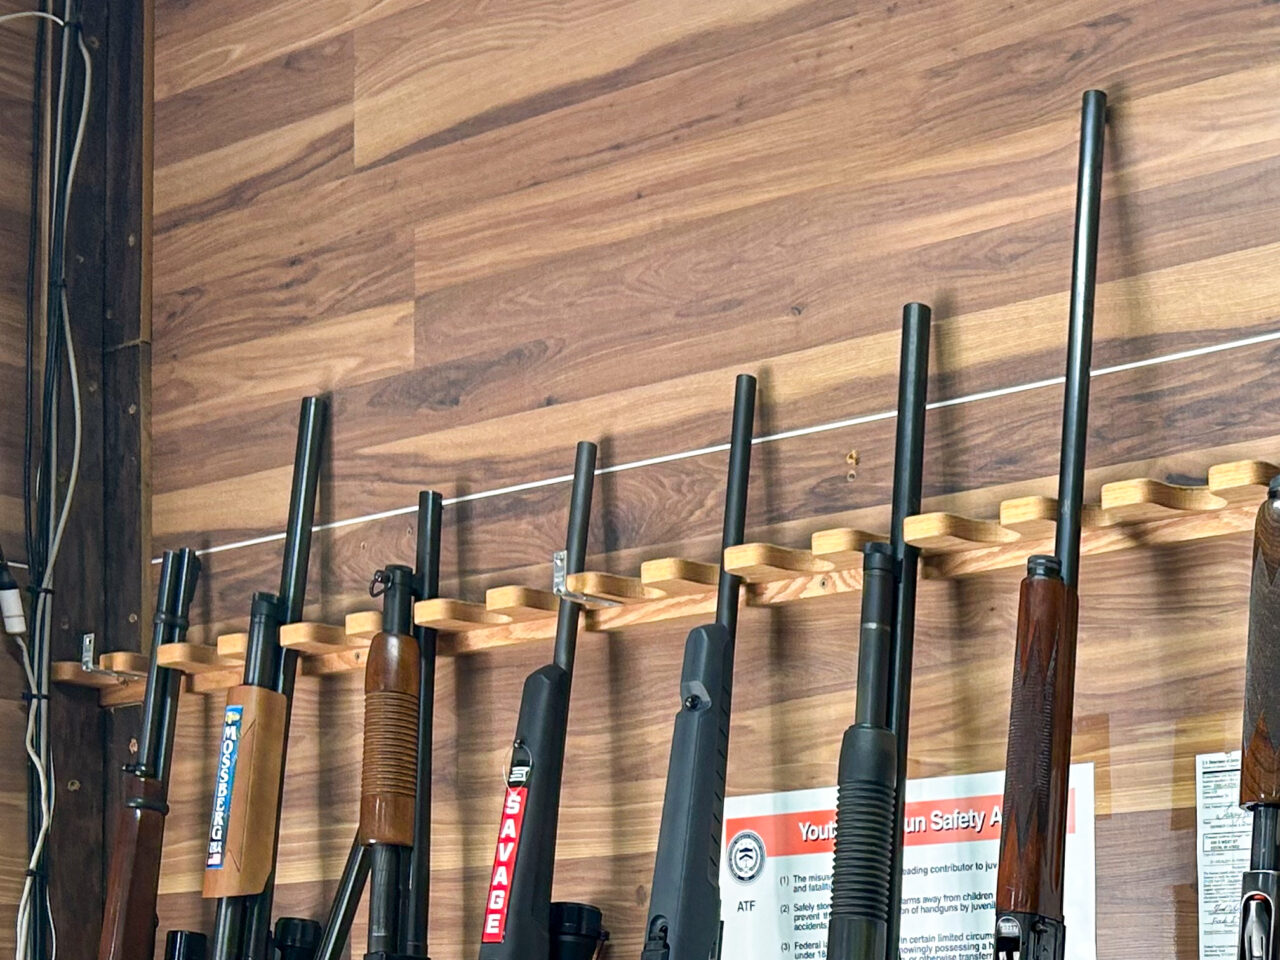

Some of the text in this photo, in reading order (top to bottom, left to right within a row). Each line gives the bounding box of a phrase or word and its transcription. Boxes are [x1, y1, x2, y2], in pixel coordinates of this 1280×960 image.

[211, 724, 236, 841] MOSSBERG
[798, 821, 838, 842] Yout
[930, 808, 985, 833] Safety
[485, 794, 521, 934] SAVAGE
[930, 863, 974, 873] contributor
[975, 862, 983, 870] to
[793, 885, 807, 893] and
[738, 900, 756, 912] ATF
[793, 902, 815, 912] Safely
[922, 896, 941, 906] away
[943, 894, 960, 902] from
[962, 892, 993, 900] children
[794, 912, 820, 923] prevent
[911, 906, 919, 914] of
[920, 904, 958, 914] handguns
[960, 904, 971, 912] by
[794, 941, 822, 949] Federal
[909, 935, 936, 943] certain
[937, 933, 964, 941] limited
[794, 951, 815, 959] under
[900, 946, 932, 955] nowingly
[935, 942, 979, 953] possessing
